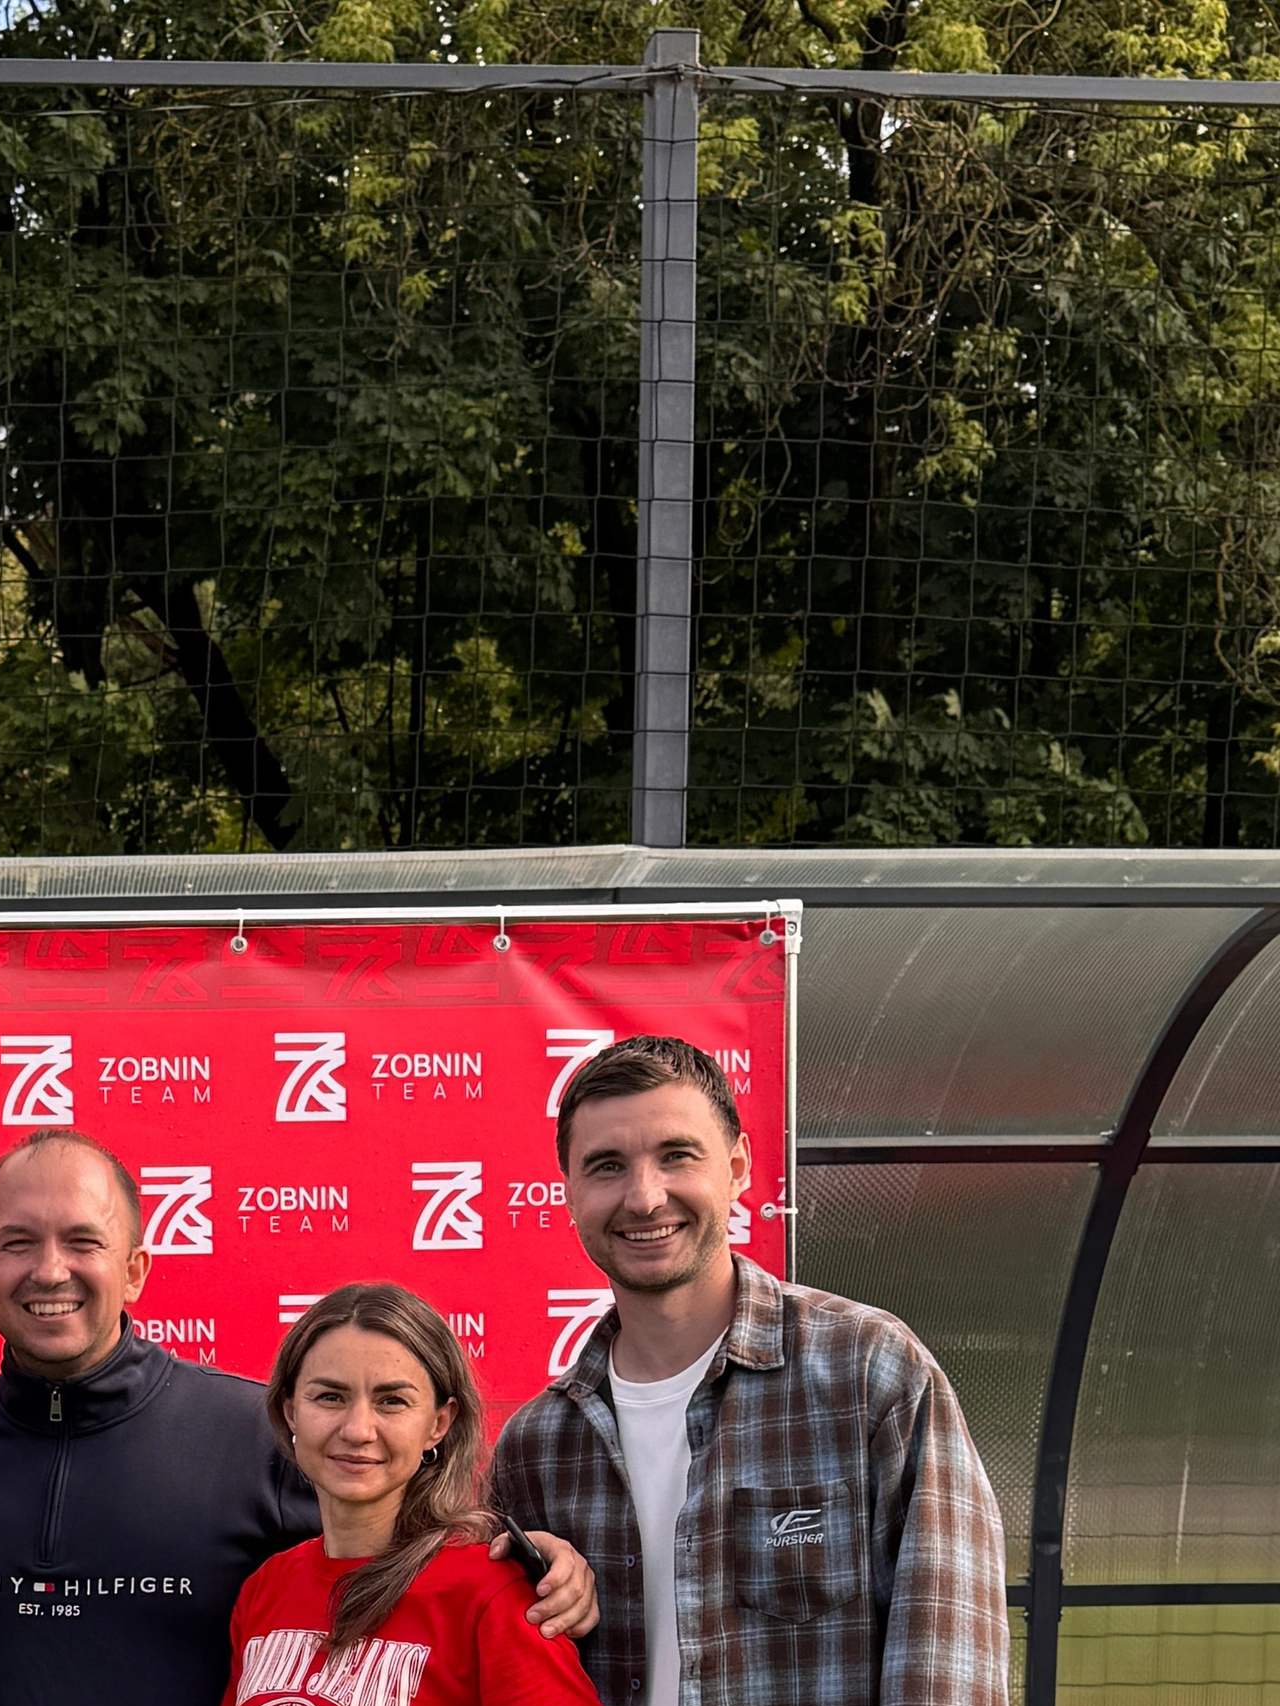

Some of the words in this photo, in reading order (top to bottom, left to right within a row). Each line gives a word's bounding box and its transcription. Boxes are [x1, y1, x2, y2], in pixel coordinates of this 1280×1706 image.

[99, 1056, 210, 1082] ZOBNIN
[371, 1053, 482, 1078] ZOBNIN
[100, 1085, 211, 1103] TEAM
[371, 1081, 483, 1099] TEAM
[238, 1186, 348, 1212] ZOBNIN
[238, 1215, 349, 1233] TEAM
[764, 1532, 824, 1548] PURSUER
[63, 1576, 193, 1597] HILFIGER
[18, 1603, 45, 1617] EST.
[51, 1604, 81, 1617] 1985
